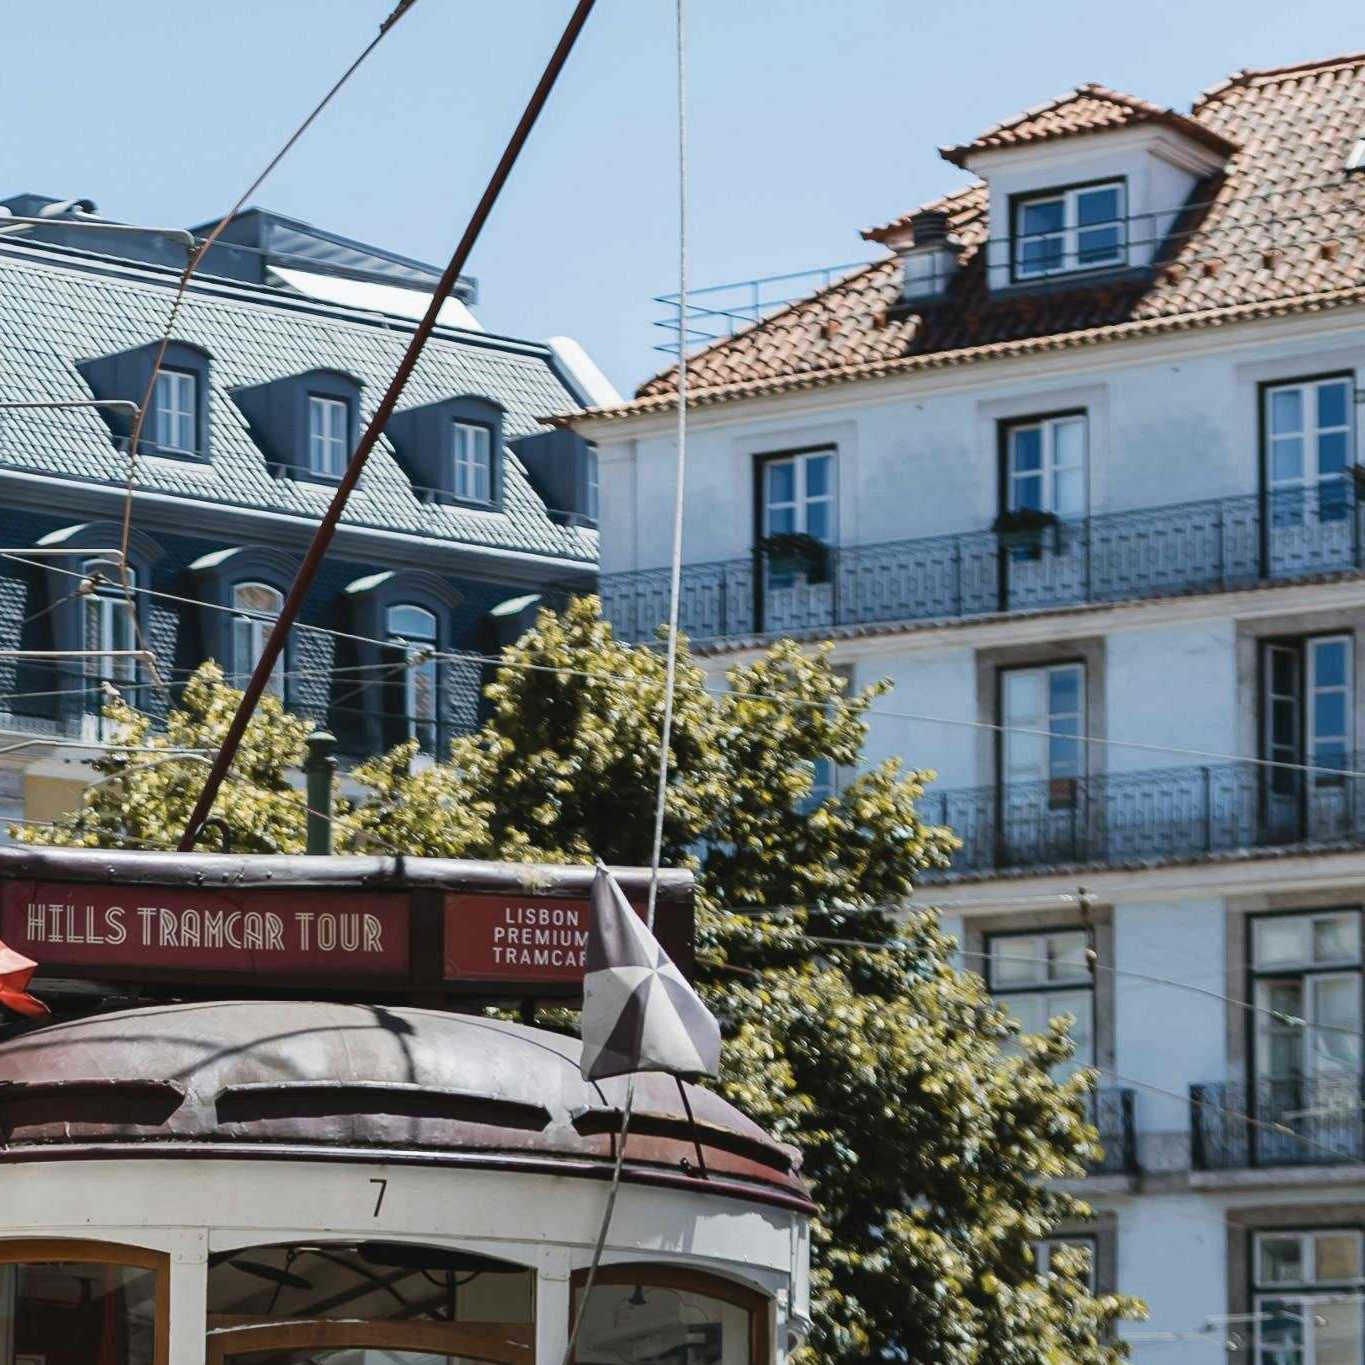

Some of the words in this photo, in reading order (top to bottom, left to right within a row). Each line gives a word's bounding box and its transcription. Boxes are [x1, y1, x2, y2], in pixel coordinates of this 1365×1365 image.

[26, 903, 128, 945] HILLS
[136, 906, 286, 951] TRAMCAR
[294, 911, 384, 952] TOUR
[505, 907, 579, 927] LISBON
[493, 926, 589, 948] PREMIUM
[369, 1178, 388, 1218] 7
